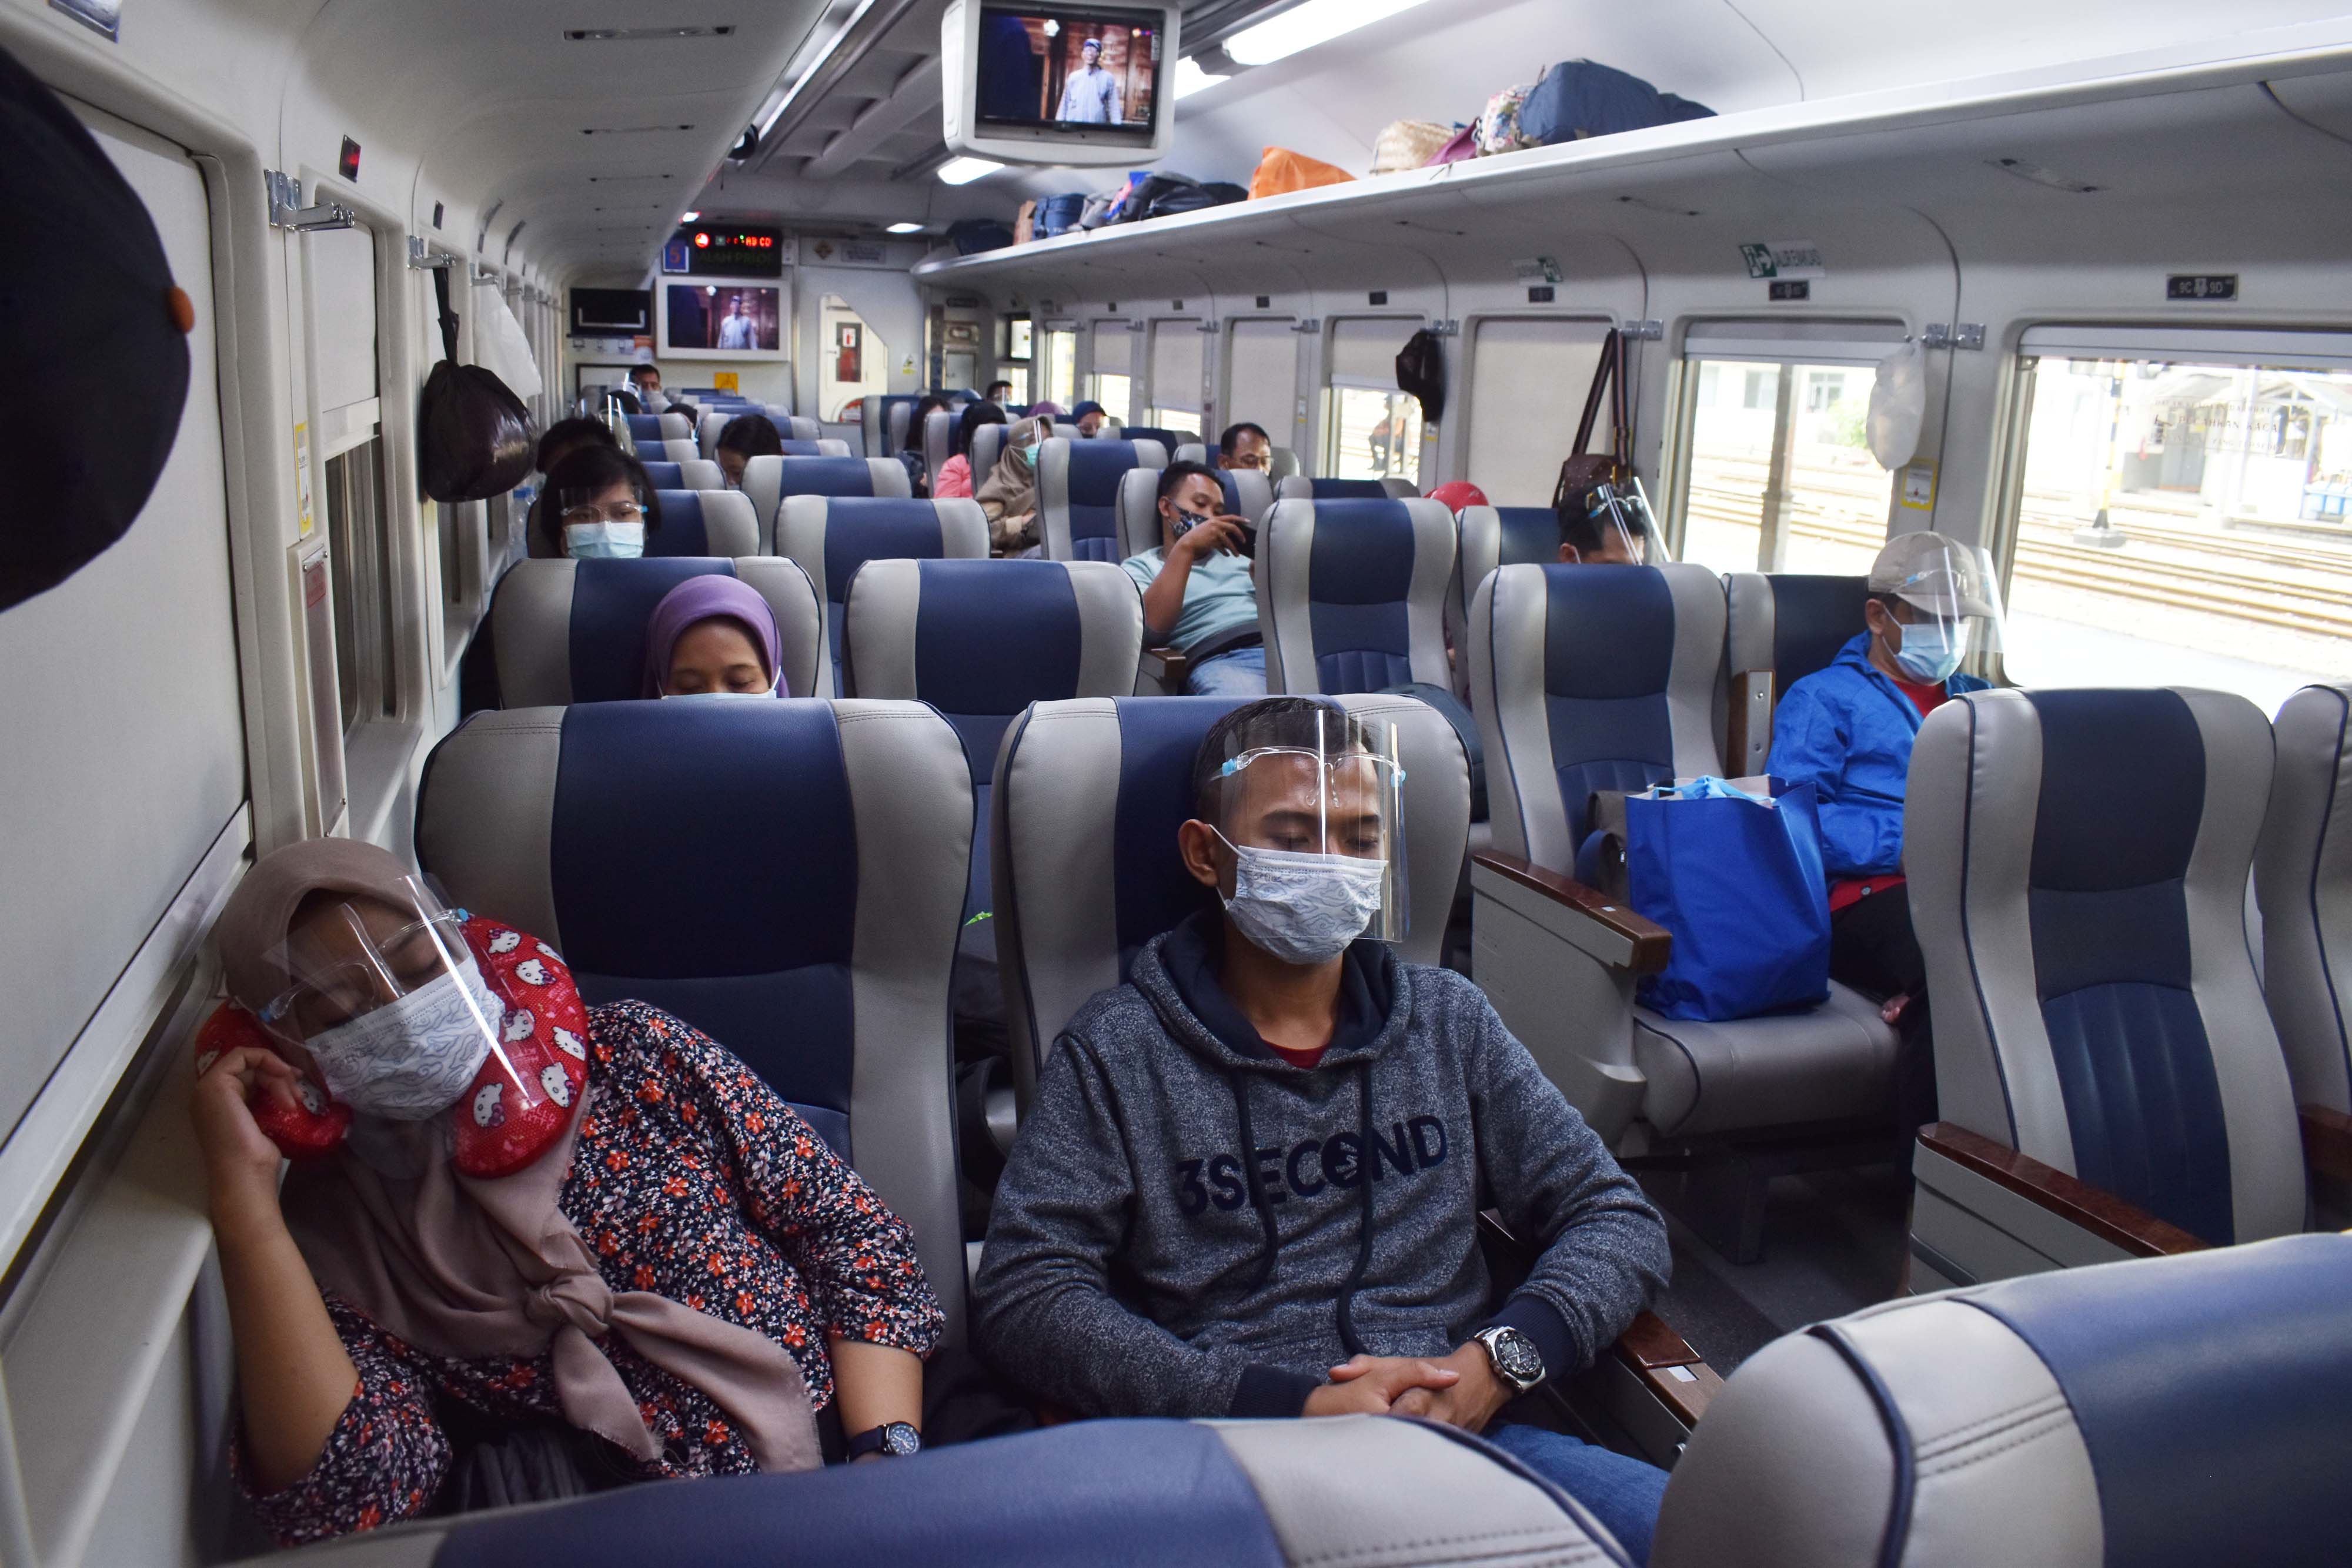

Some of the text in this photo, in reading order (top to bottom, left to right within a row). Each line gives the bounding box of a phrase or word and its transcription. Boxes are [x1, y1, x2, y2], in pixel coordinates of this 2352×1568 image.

[669, 248, 680, 263] 5
[2179, 282, 2193, 293] 9C
[2210, 282, 2224, 294] 9D
